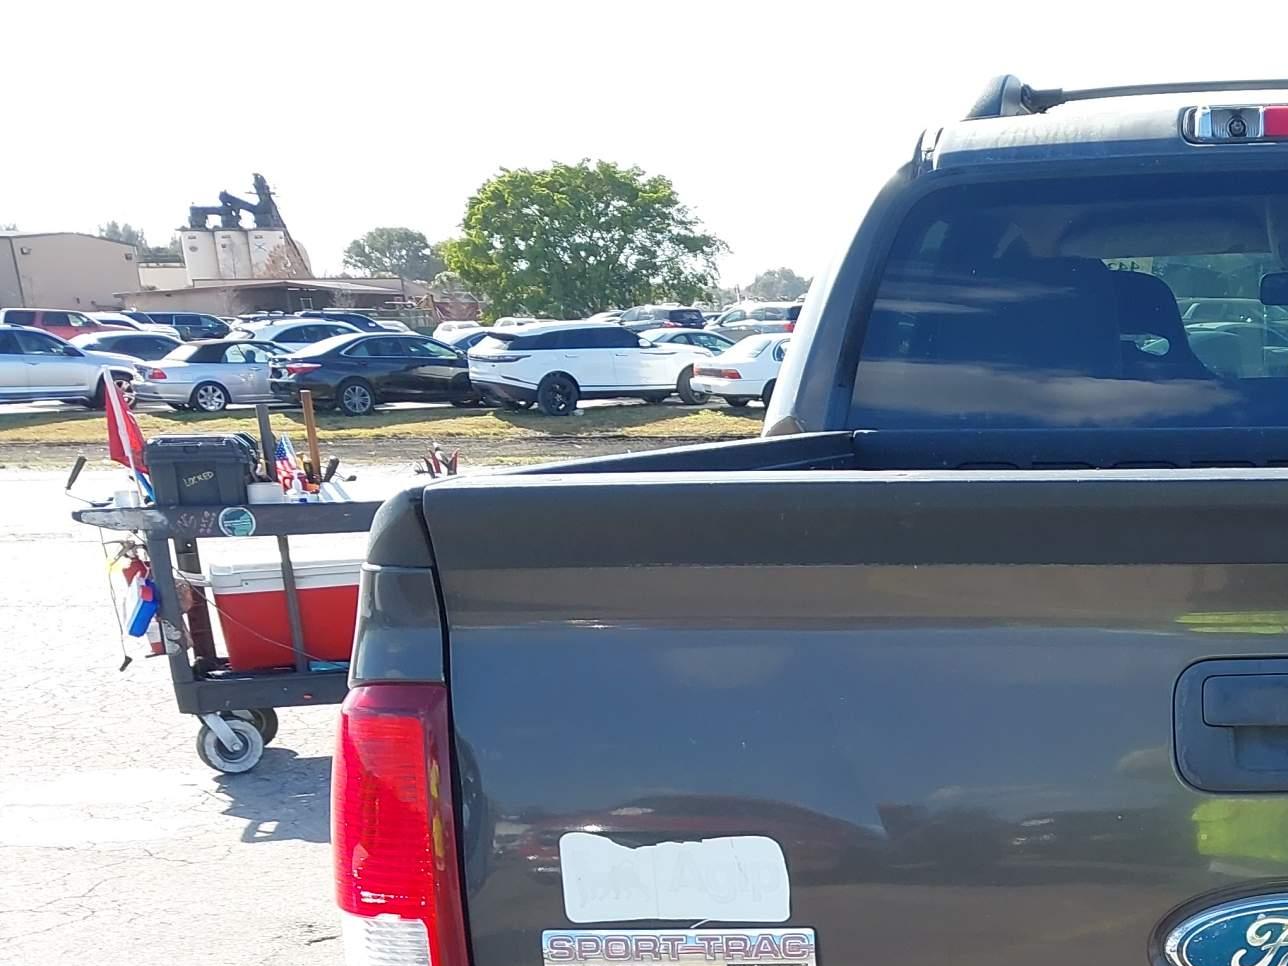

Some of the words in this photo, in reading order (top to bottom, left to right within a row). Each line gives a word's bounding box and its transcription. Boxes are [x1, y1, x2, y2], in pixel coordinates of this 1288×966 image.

[183, 471, 214, 487] LOCKED
[547, 935, 687, 962] SPORT
[696, 933, 811, 960] TRAC
